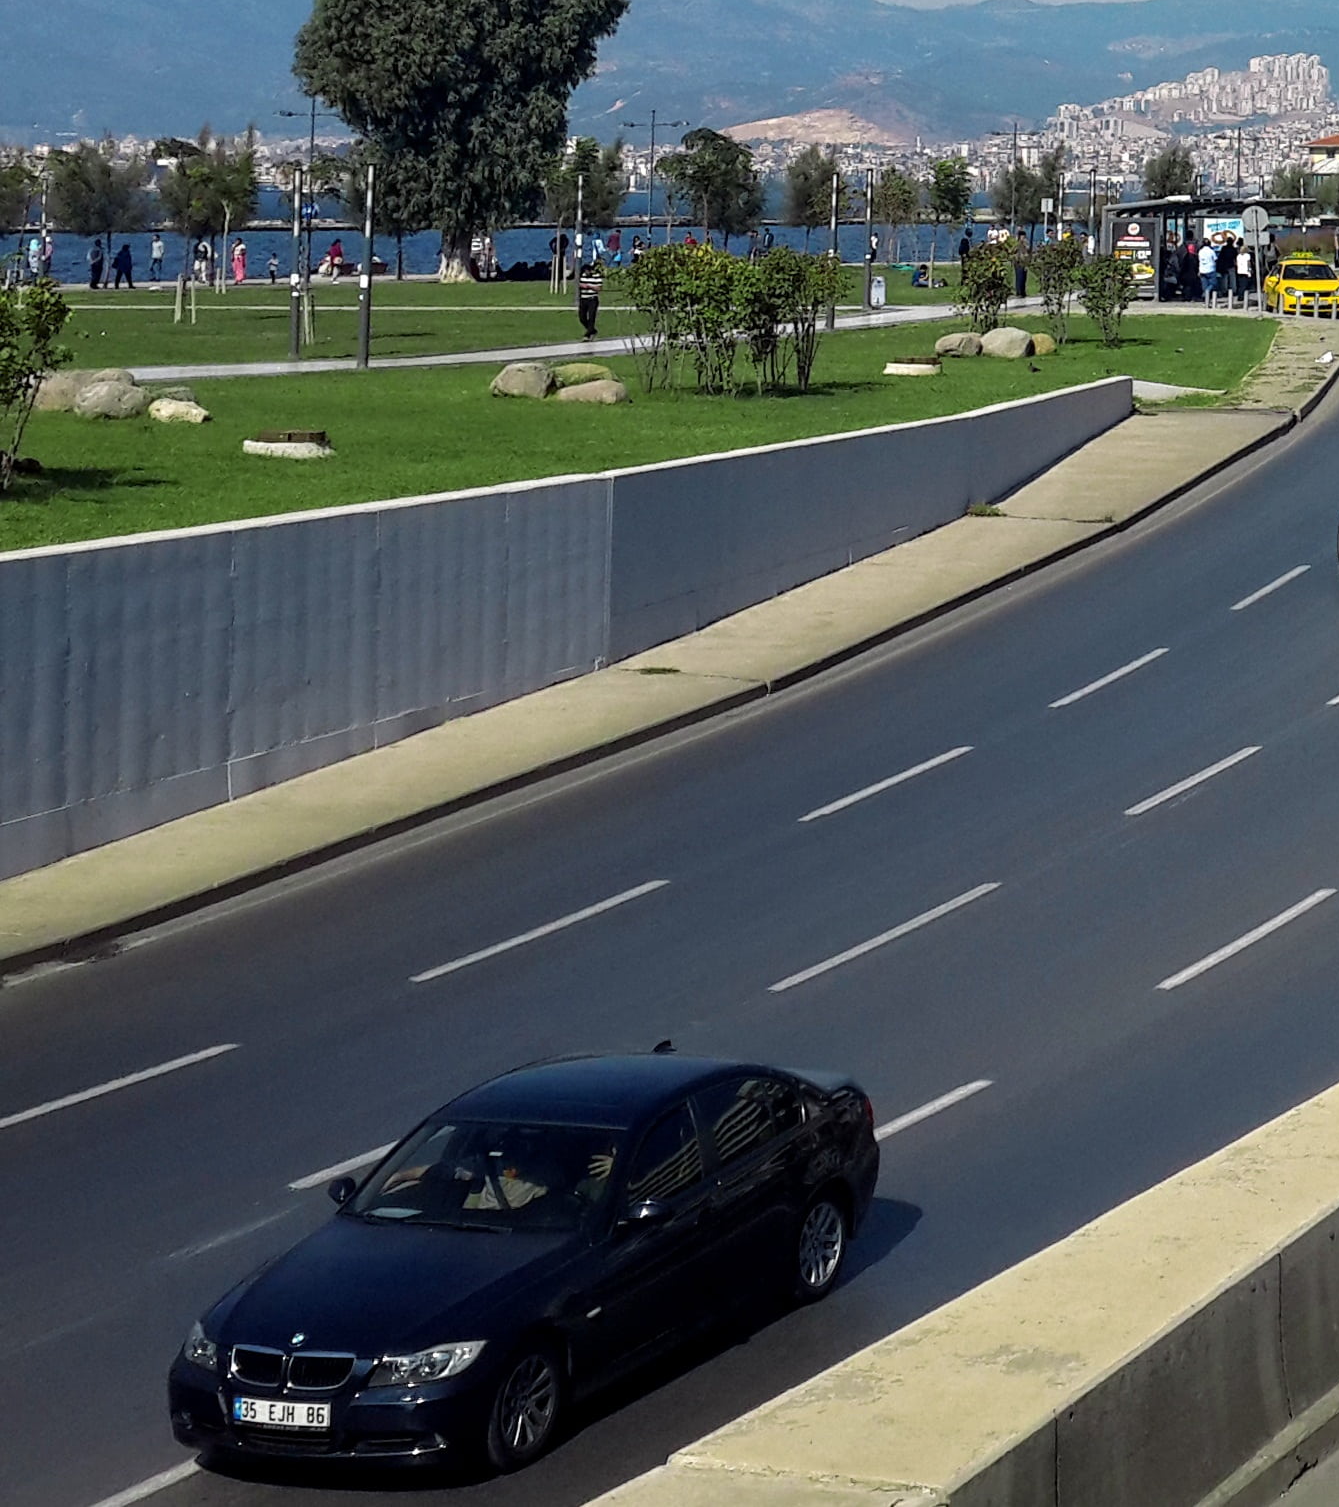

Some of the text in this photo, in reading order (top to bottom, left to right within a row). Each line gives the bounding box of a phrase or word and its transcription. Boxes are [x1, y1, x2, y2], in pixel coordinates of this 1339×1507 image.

[242, 1400, 325, 1424] 35 EJH 86
